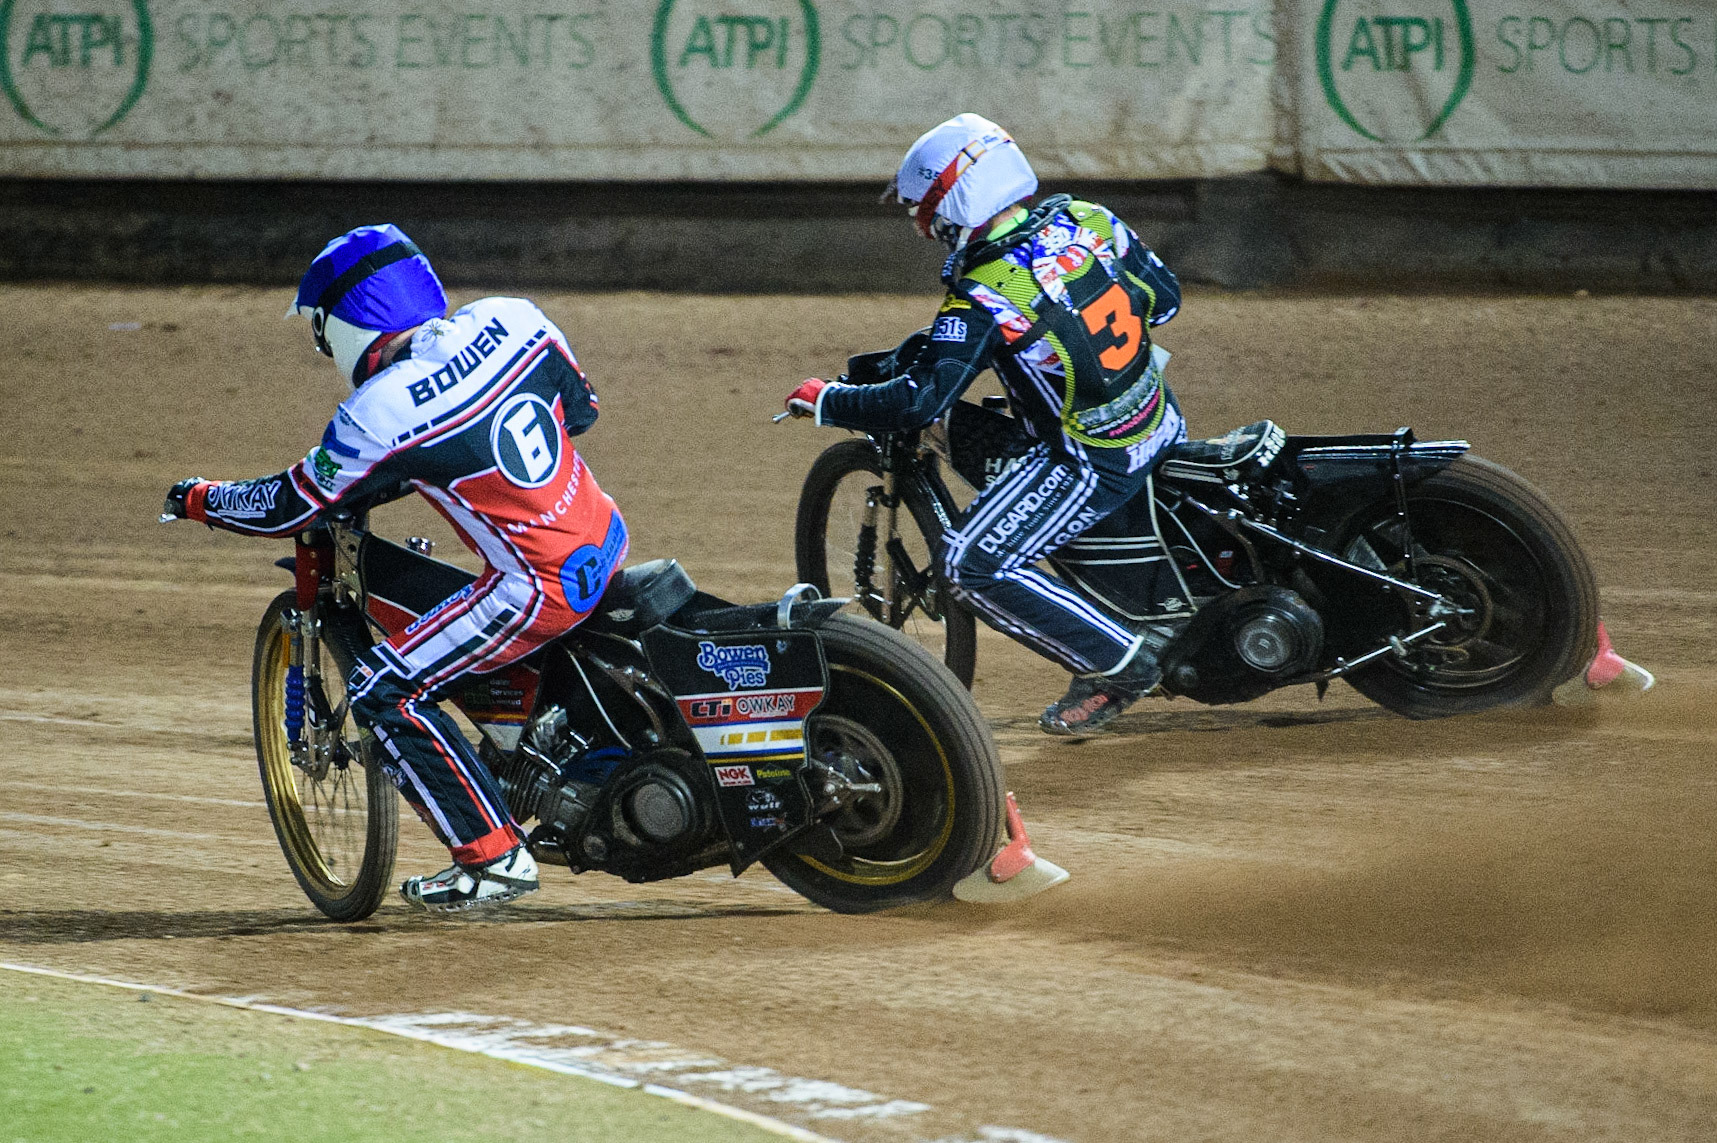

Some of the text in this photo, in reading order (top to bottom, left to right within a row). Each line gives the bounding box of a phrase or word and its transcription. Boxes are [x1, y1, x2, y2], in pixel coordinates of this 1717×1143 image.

[21, 13, 594, 72] ATPI SPORTS EVENTS
[678, 12, 1274, 70] ATPI SPORTS EVENTS
[1341, 15, 1698, 76] ATPI SPORTS
[1081, 284, 1143, 371] 3
[406, 318, 510, 407] BOWEN
[503, 401, 553, 482] 6
[977, 464, 1071, 554] DUGARD.com
[697, 642, 768, 669] Bowen
[724, 667, 766, 691] Pies
[736, 694, 795, 714] OWKAY
[718, 768, 749, 781] NGK
